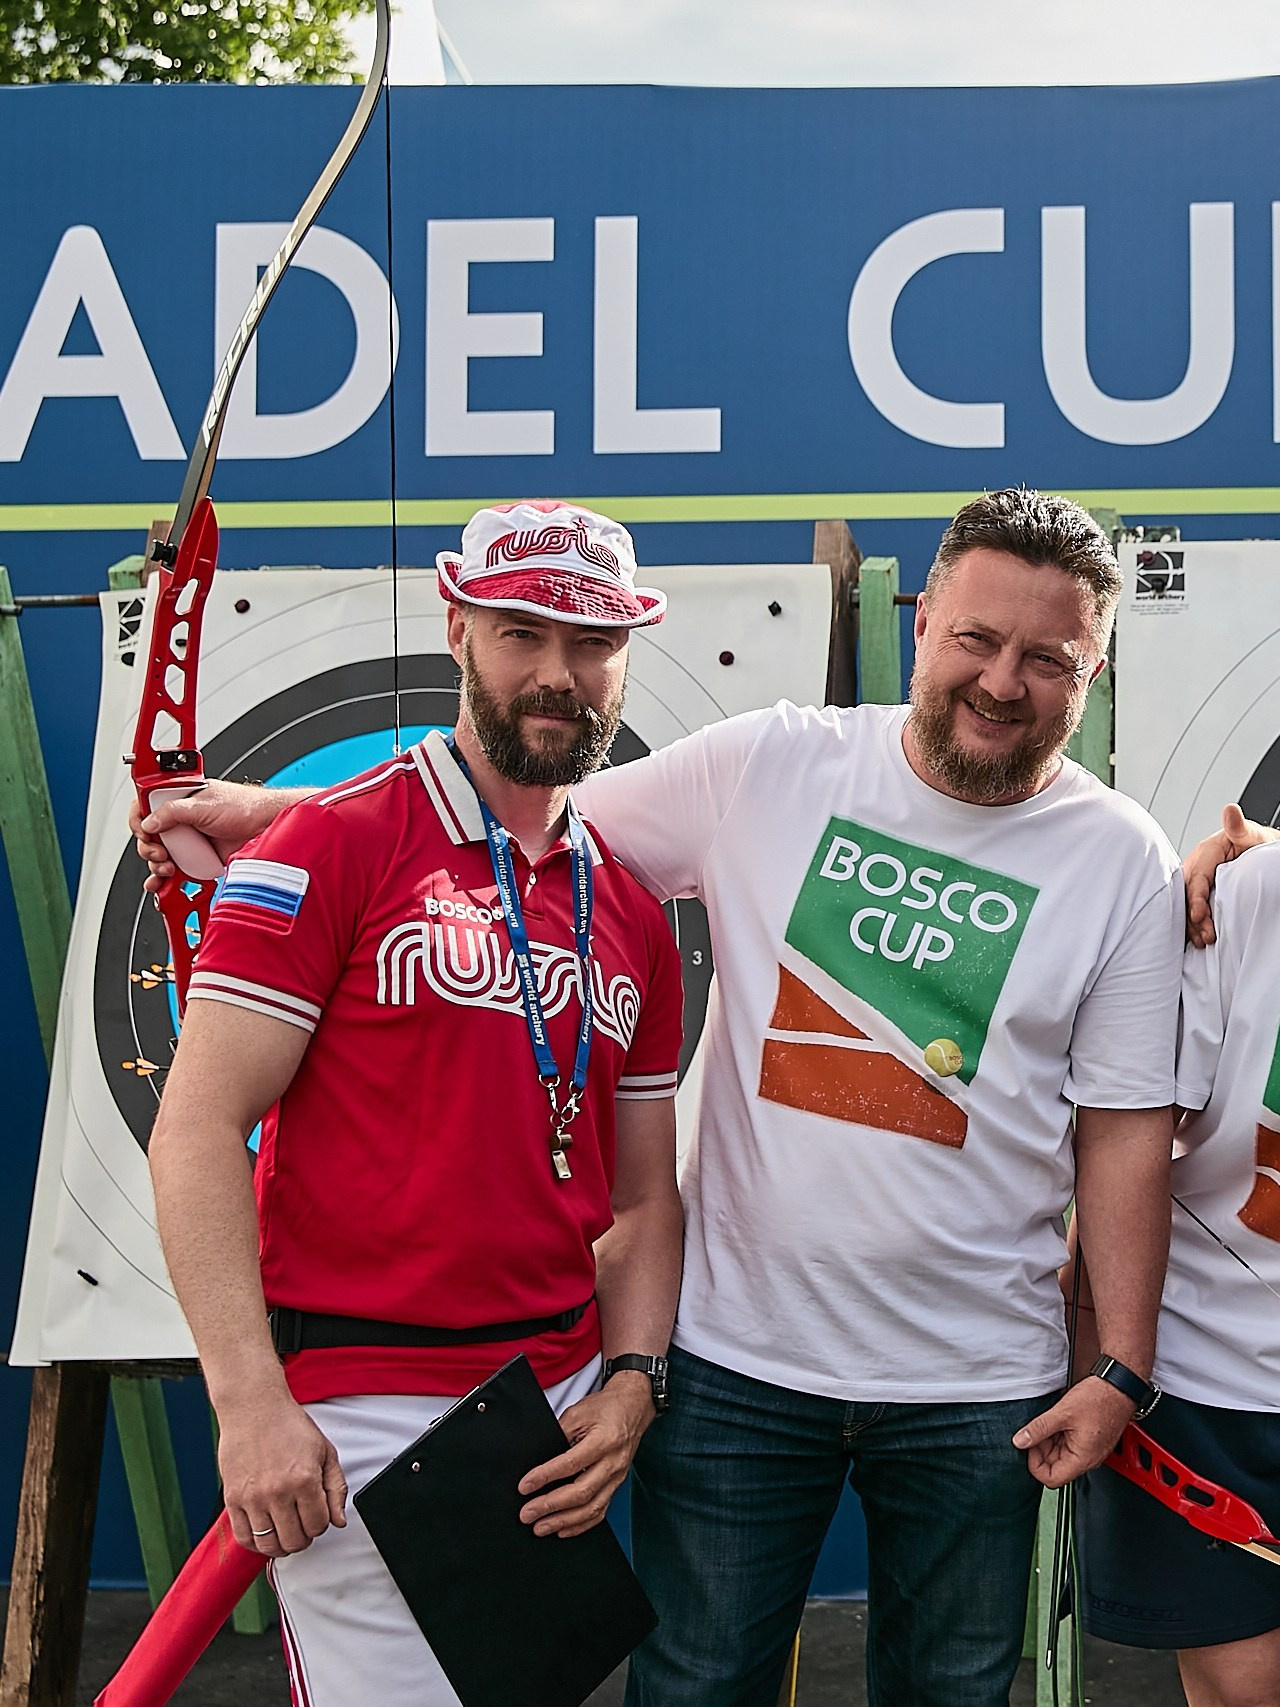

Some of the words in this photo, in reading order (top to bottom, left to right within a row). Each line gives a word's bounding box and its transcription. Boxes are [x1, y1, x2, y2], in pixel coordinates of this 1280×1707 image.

[202, 218, 299, 449] RECRUIT
[489, 821, 519, 928] www.worldarchery.org
[819, 835, 1018, 933] BOSCO
[425, 897, 493, 925] BOSCO
[692, 950, 703, 966] 3
[849, 907, 955, 970] CUP
[522, 968, 537, 1000] world
[529, 1000, 546, 1046] archery
[581, 1001, 593, 1044] archery
